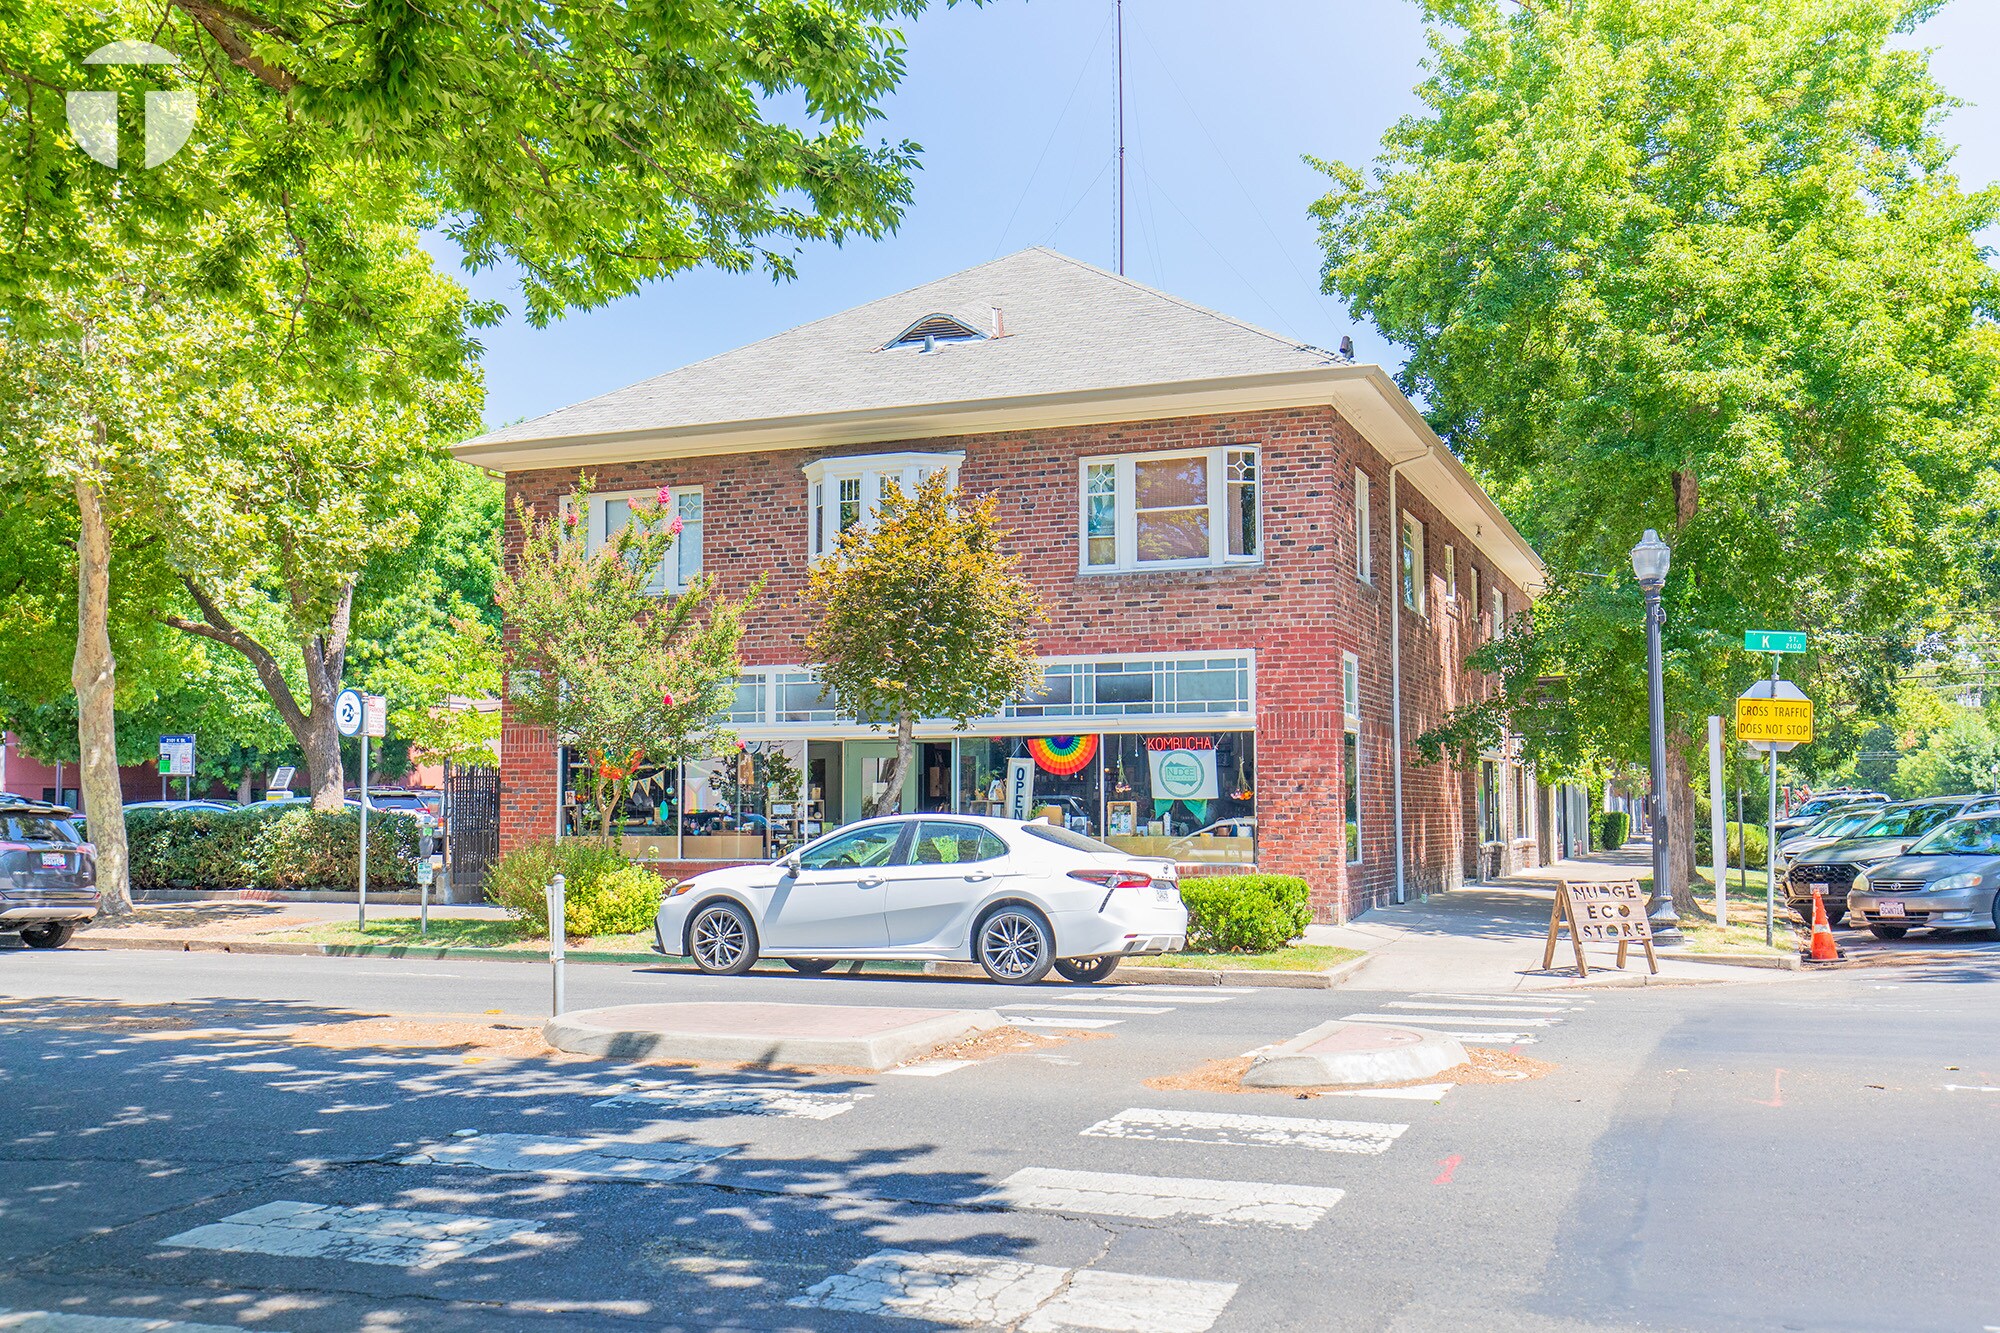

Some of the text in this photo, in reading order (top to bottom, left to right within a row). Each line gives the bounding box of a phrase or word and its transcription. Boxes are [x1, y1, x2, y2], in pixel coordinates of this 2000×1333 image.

[1762, 635, 1770, 649] K
[1741, 705, 1808, 718] CROSS TRAFFIC
[1740, 722, 1808, 736] DOES NOT STOP
[1147, 736, 1212, 750] KOMBUCHA
[1014, 767, 1025, 819] OPEN
[1572, 885, 1636, 900] NUDGE
[1587, 904, 1630, 919] ECO
[1583, 922, 1645, 938] STORE
